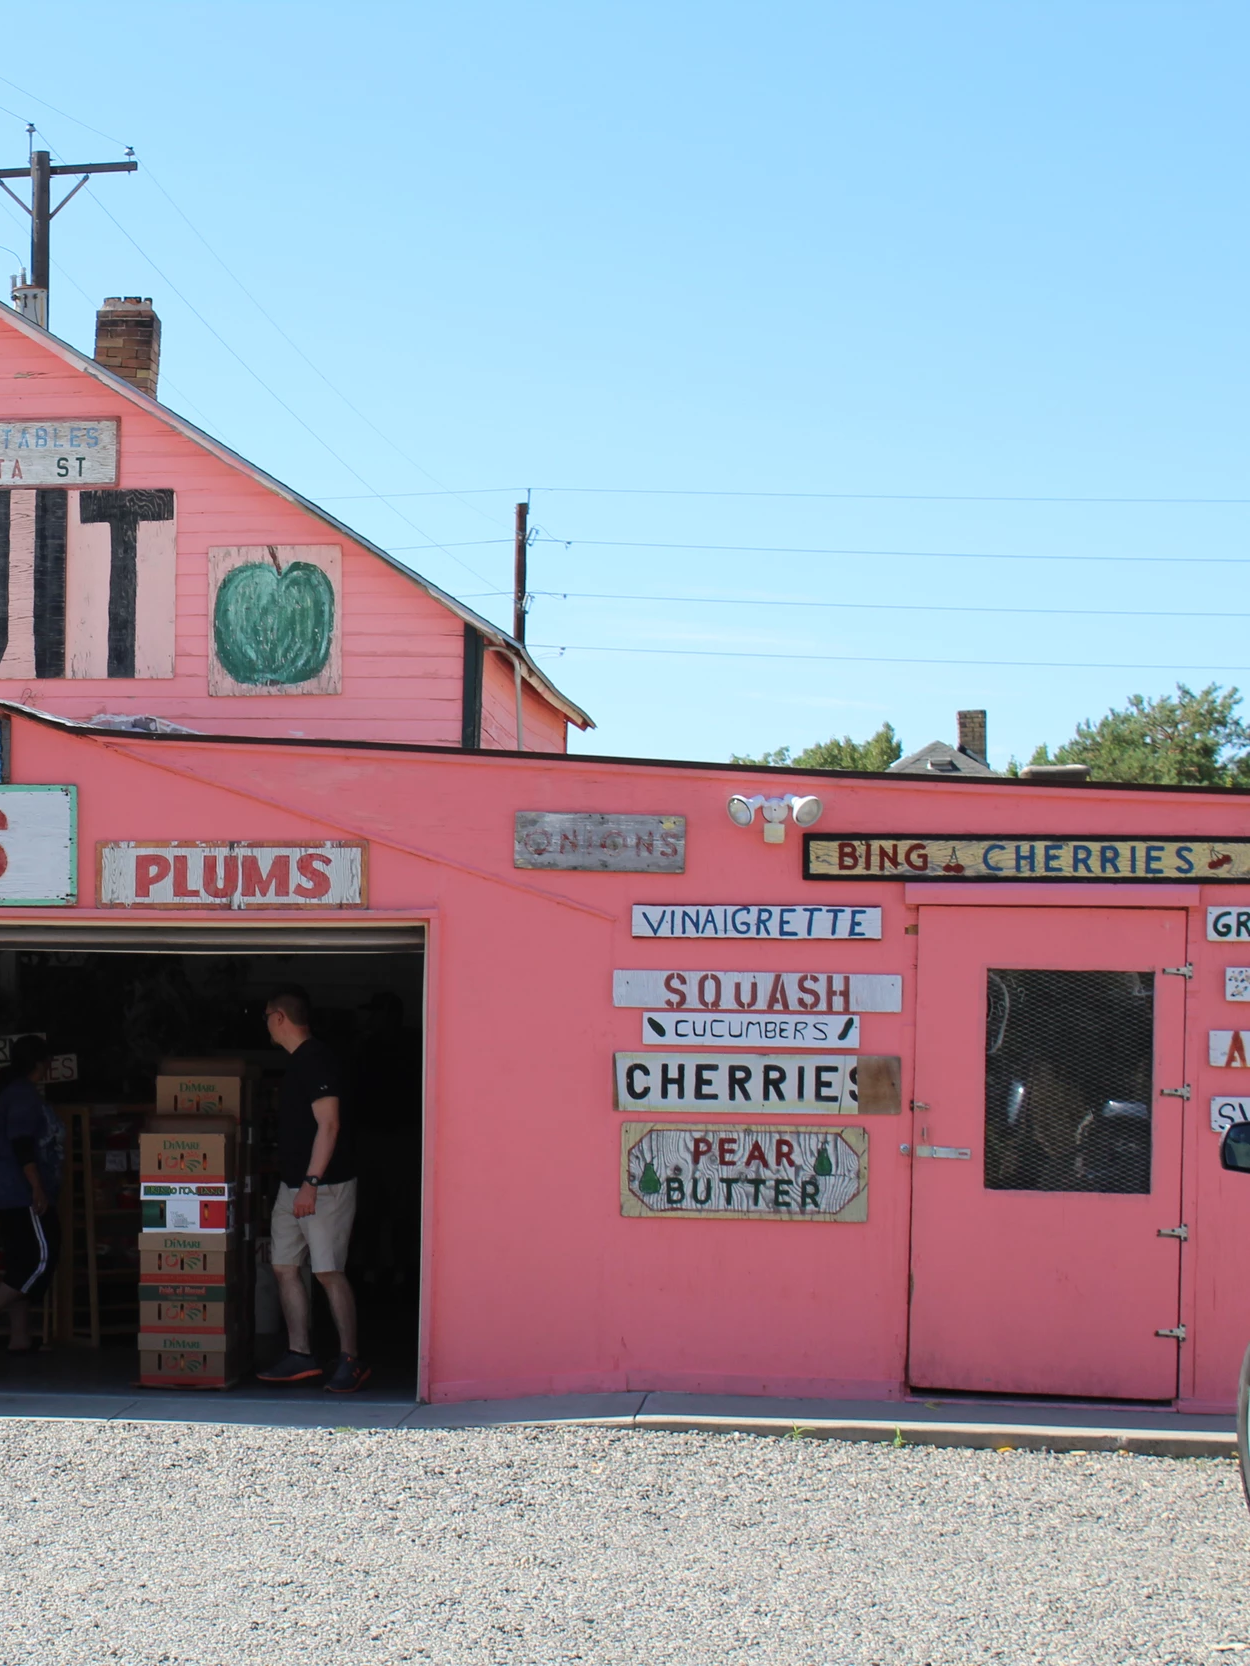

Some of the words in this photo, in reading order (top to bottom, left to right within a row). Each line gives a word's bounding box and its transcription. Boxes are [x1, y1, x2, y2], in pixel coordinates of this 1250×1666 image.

[56, 457, 86, 477] ST
[525, 828, 679, 858] ONIONS
[839, 842, 929, 873] BING
[982, 843, 1195, 875] CHERRIES
[135, 852, 333, 899] PLUMS
[642, 907, 867, 938] VINAIGRETTE
[664, 972, 851, 1011] SQUASH
[674, 1020, 828, 1041] CUCUMBERS
[692, 1138, 795, 1168] PEAR
[666, 1177, 821, 1209] BUTTER
